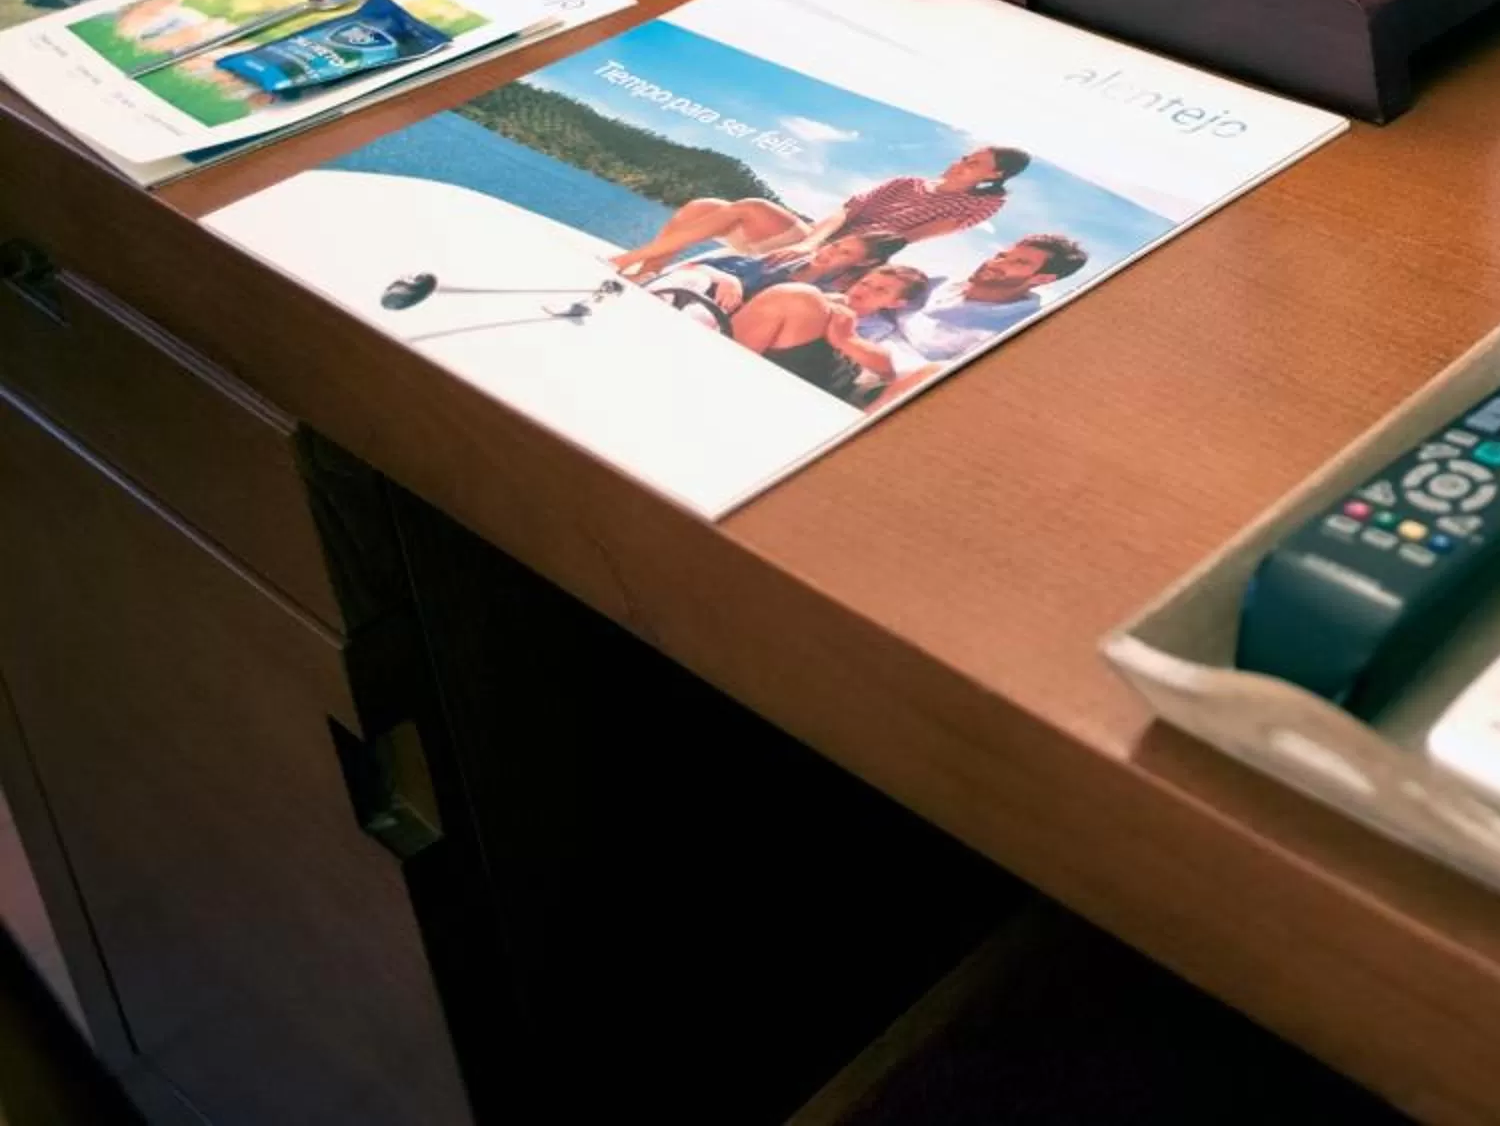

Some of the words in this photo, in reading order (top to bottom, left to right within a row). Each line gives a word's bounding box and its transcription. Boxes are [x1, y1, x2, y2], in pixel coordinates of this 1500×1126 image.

[660, 96, 721, 124] para
[715, 118, 758, 139] ser
[751, 129, 804, 159] feliz
[1062, 68, 1249, 139] alentejo
